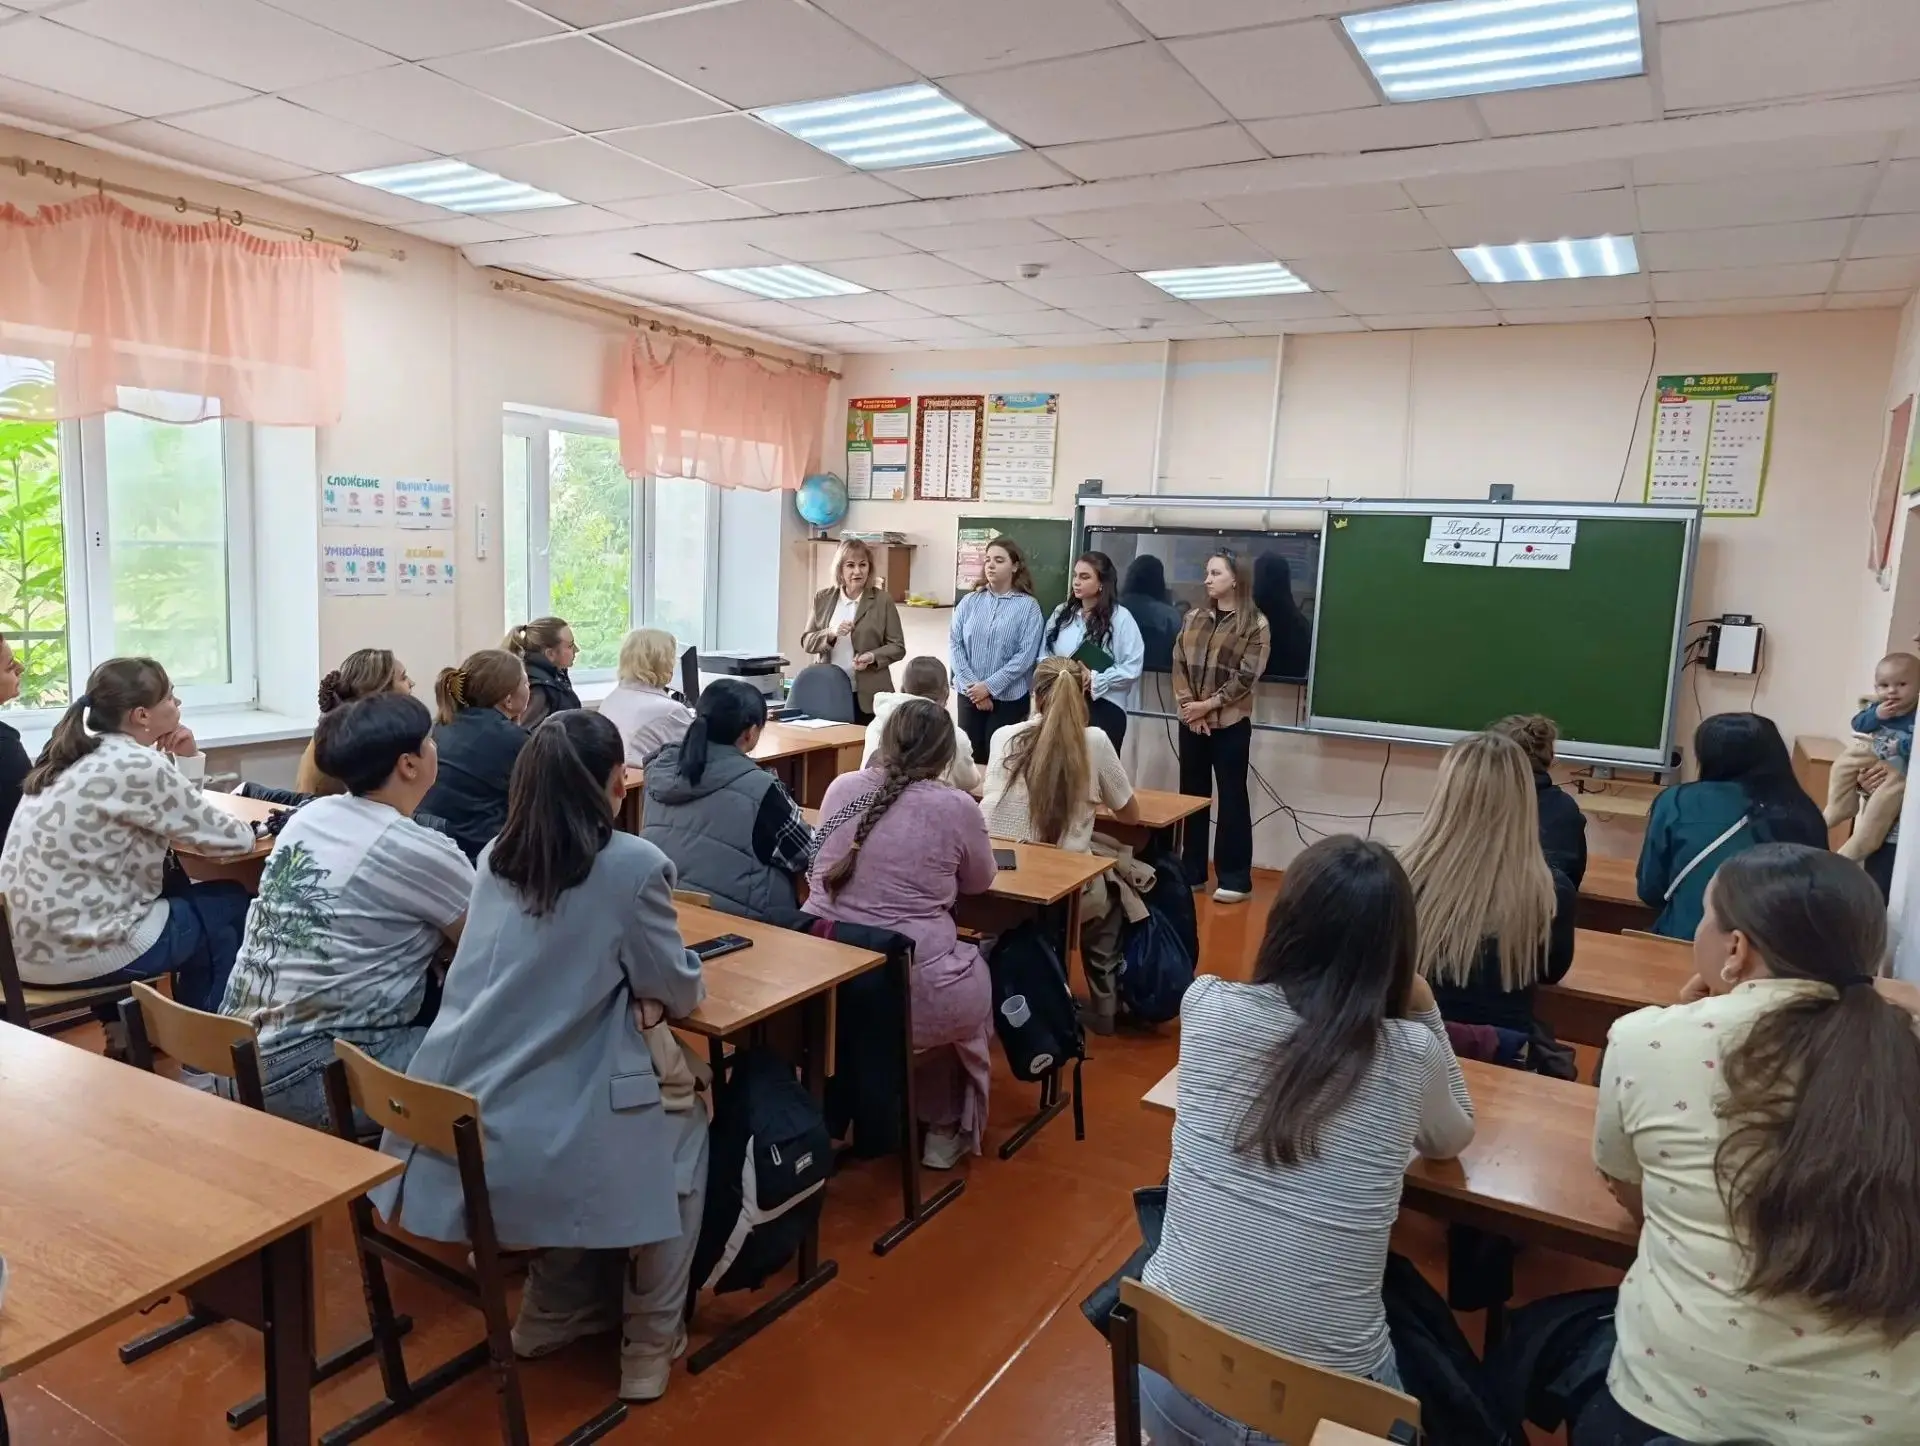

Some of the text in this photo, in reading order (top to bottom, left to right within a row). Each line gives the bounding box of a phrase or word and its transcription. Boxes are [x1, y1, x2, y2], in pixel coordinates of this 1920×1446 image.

[1699, 376, 1738, 385] ЗВУКИ
[327, 475, 380, 489] СЛОЖЕНИЕ
[395, 480, 451, 493] ВЫЧИТАНИЕ
[1443, 520, 1571, 541] Первое октября
[324, 546, 384, 558] УМНОЖЕНИЕ
[1431, 544, 1560, 564] Классная работа
